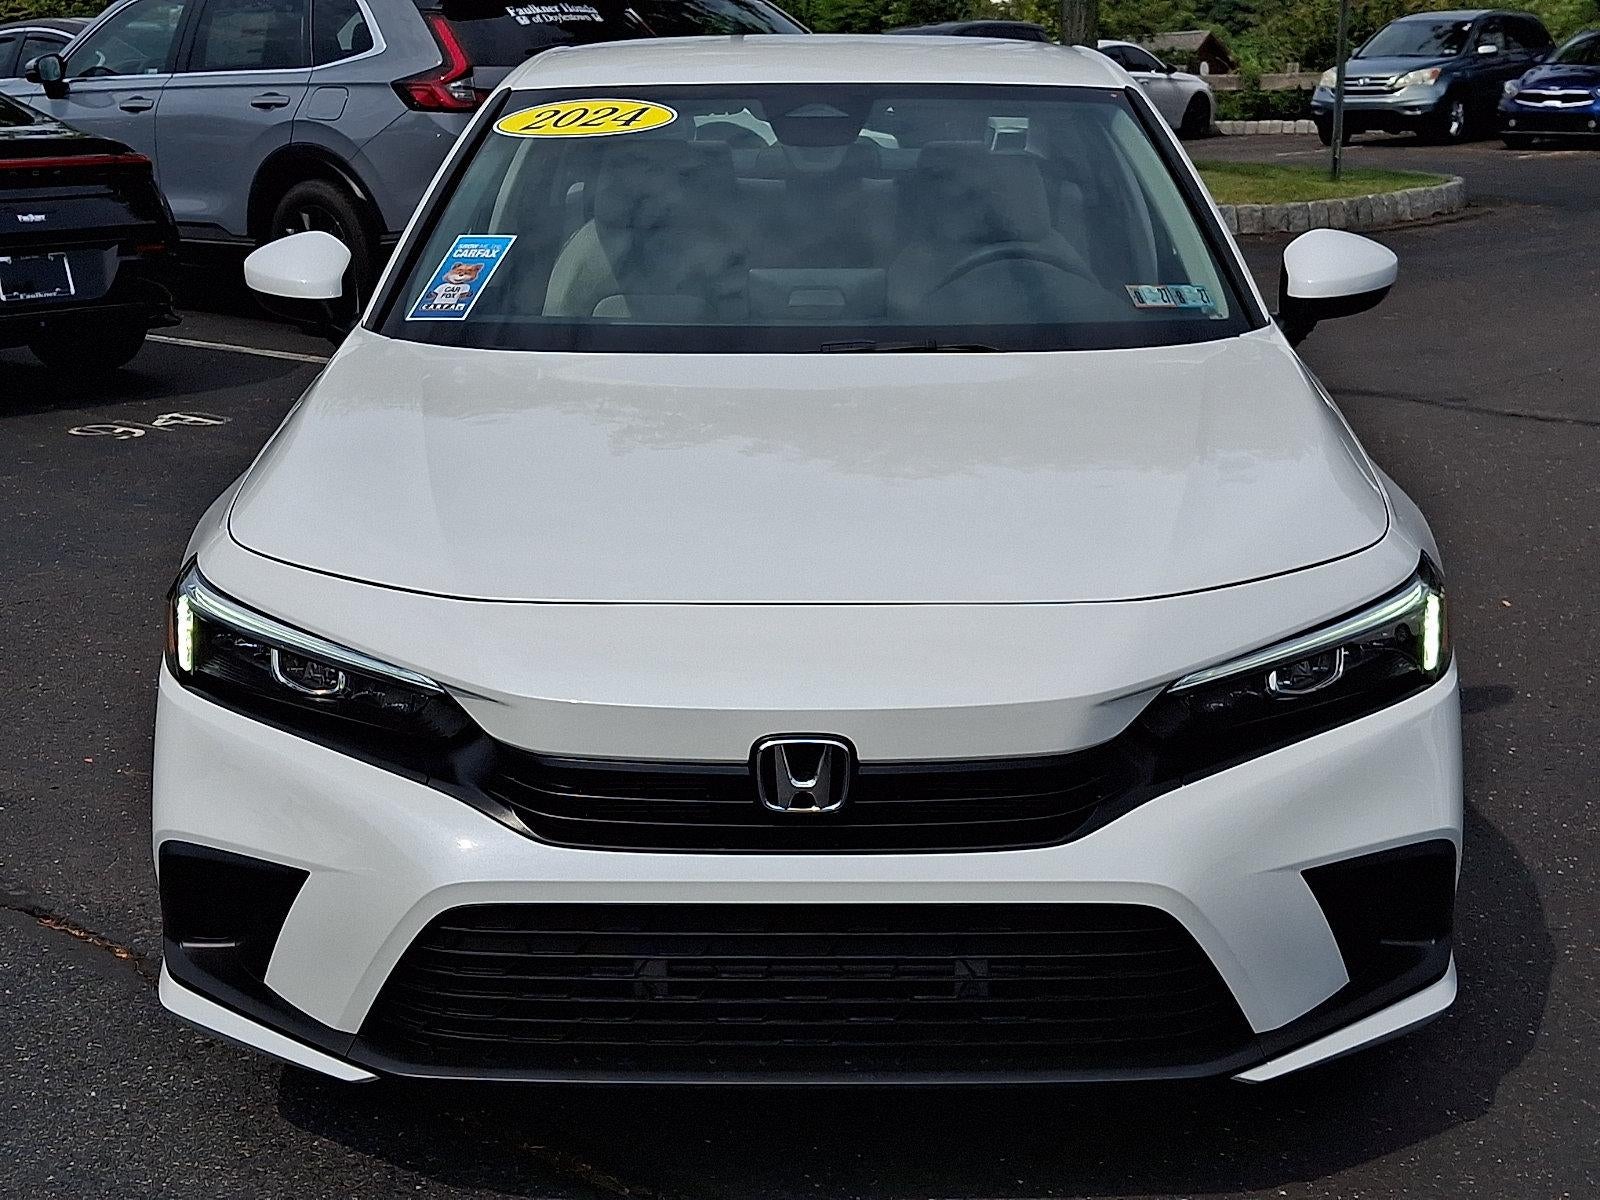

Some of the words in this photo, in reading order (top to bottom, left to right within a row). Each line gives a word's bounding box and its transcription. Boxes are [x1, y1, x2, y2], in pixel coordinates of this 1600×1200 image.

[505, 4, 560, 17] Faulkner
[559, 2, 599, 14] Honda
[519, 106, 651, 132] 2024
[452, 248, 501, 258] CARFAX
